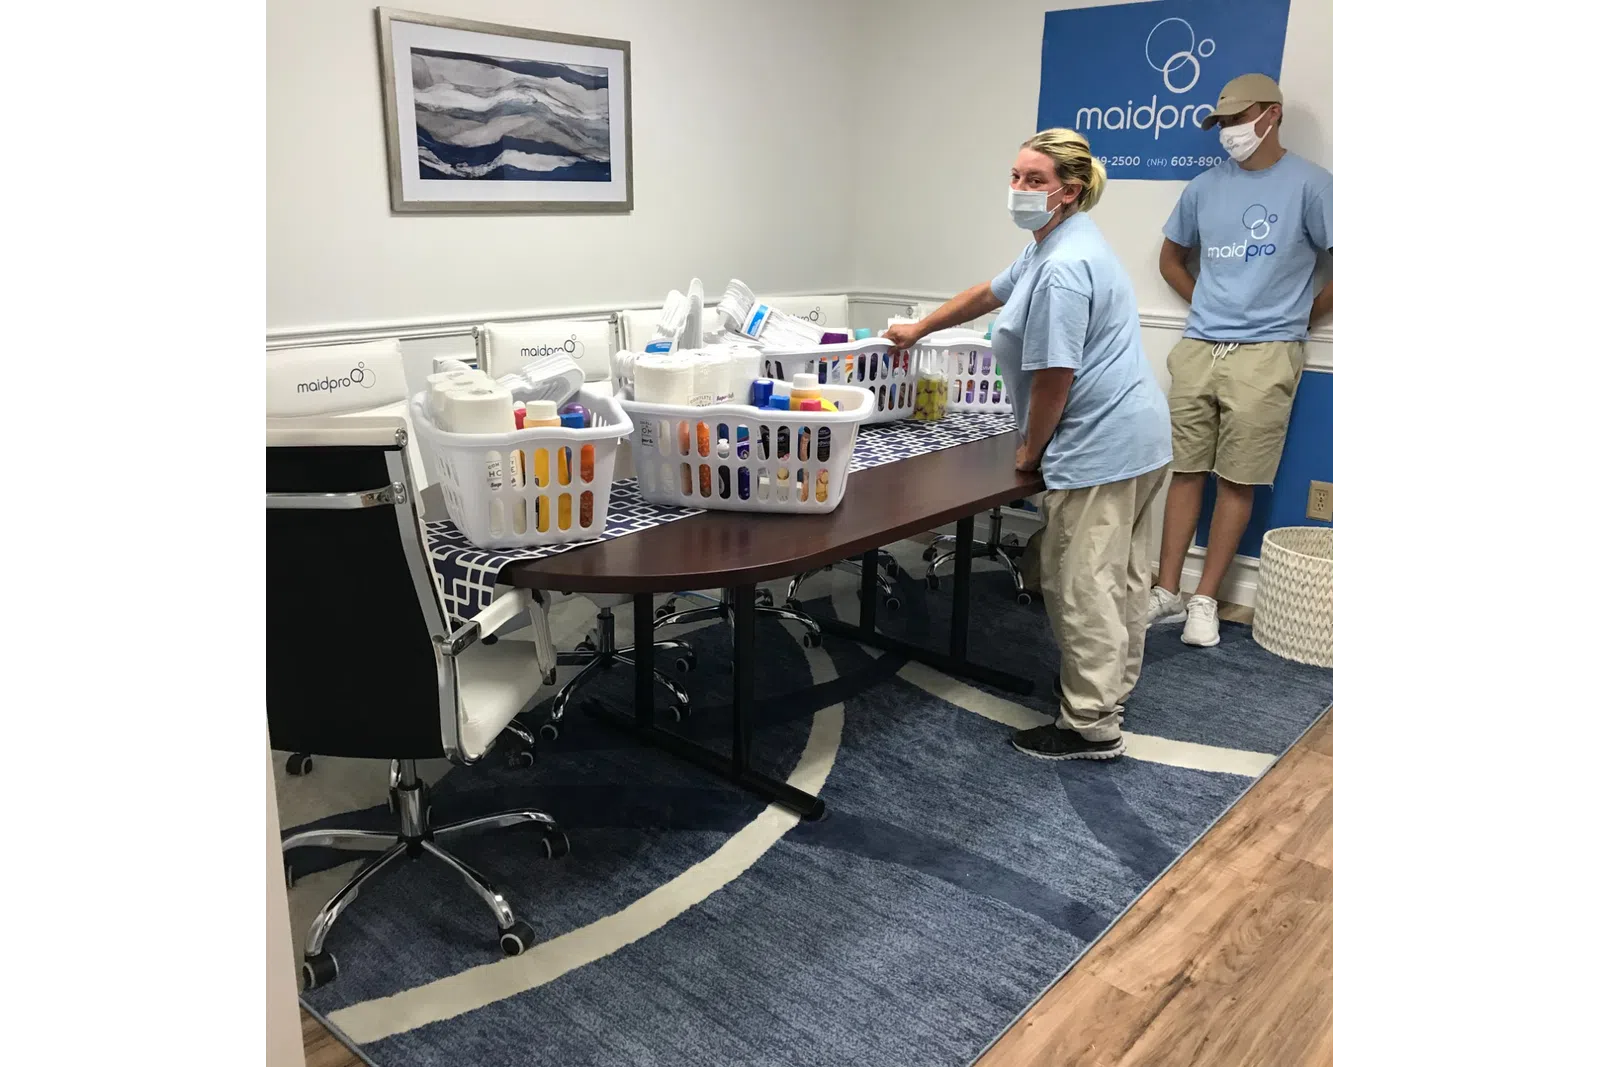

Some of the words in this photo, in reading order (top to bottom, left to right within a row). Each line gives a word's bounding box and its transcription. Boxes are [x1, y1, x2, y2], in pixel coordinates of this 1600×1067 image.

[1075, 95, 1215, 140] maidpro
[1146, 158, 1168, 167] (NH)
[1208, 239, 1276, 262] maidpro
[297, 376, 351, 393] maidpro
